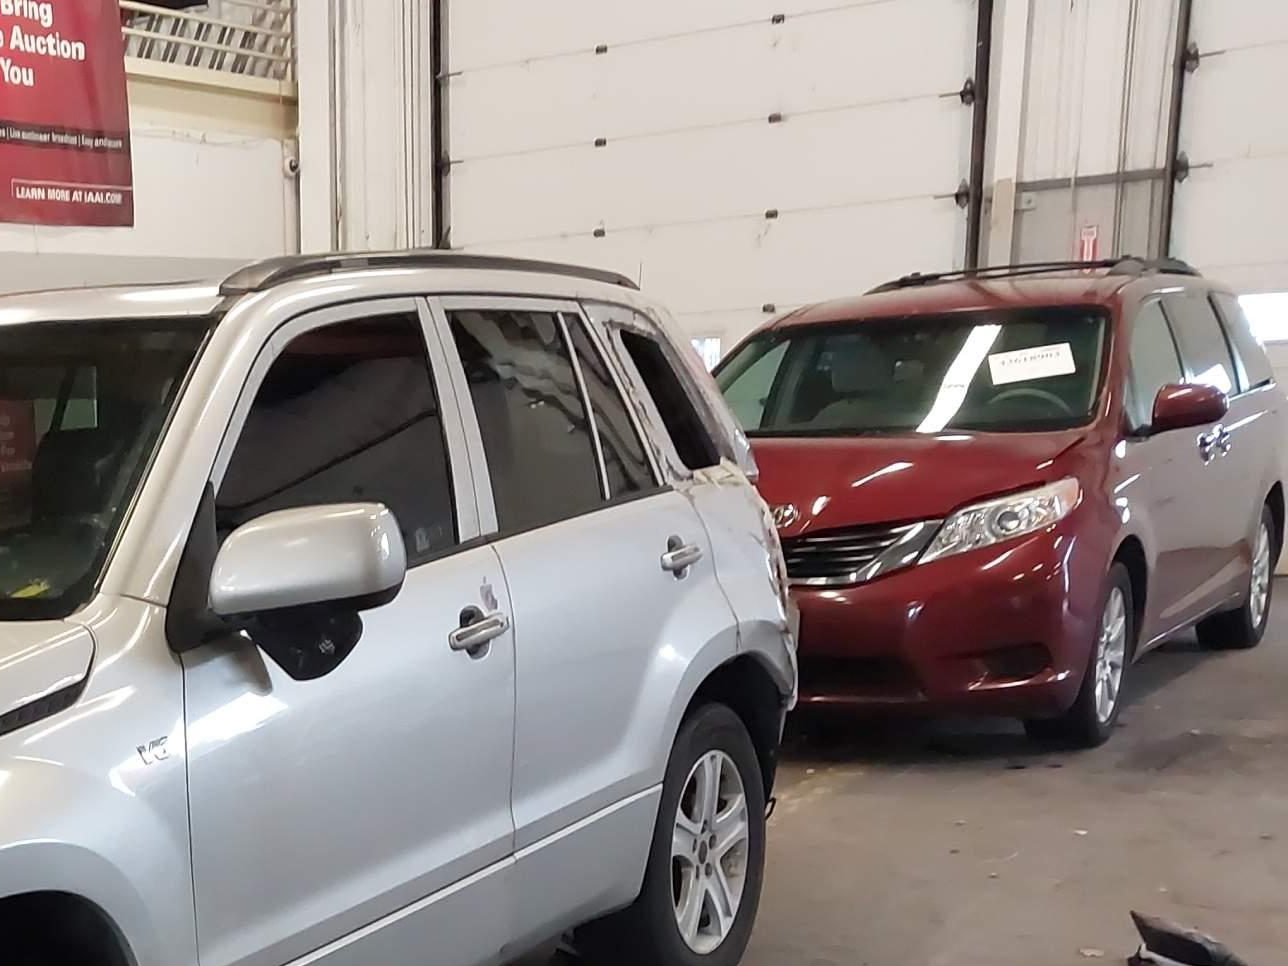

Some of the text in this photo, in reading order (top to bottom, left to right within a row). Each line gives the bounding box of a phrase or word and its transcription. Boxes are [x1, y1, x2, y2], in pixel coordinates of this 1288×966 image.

[0, 0, 53, 28] Bring
[9, 25, 85, 60] Auction
[16, 186, 122, 205] LEARN MORE AT IAAI.COM
